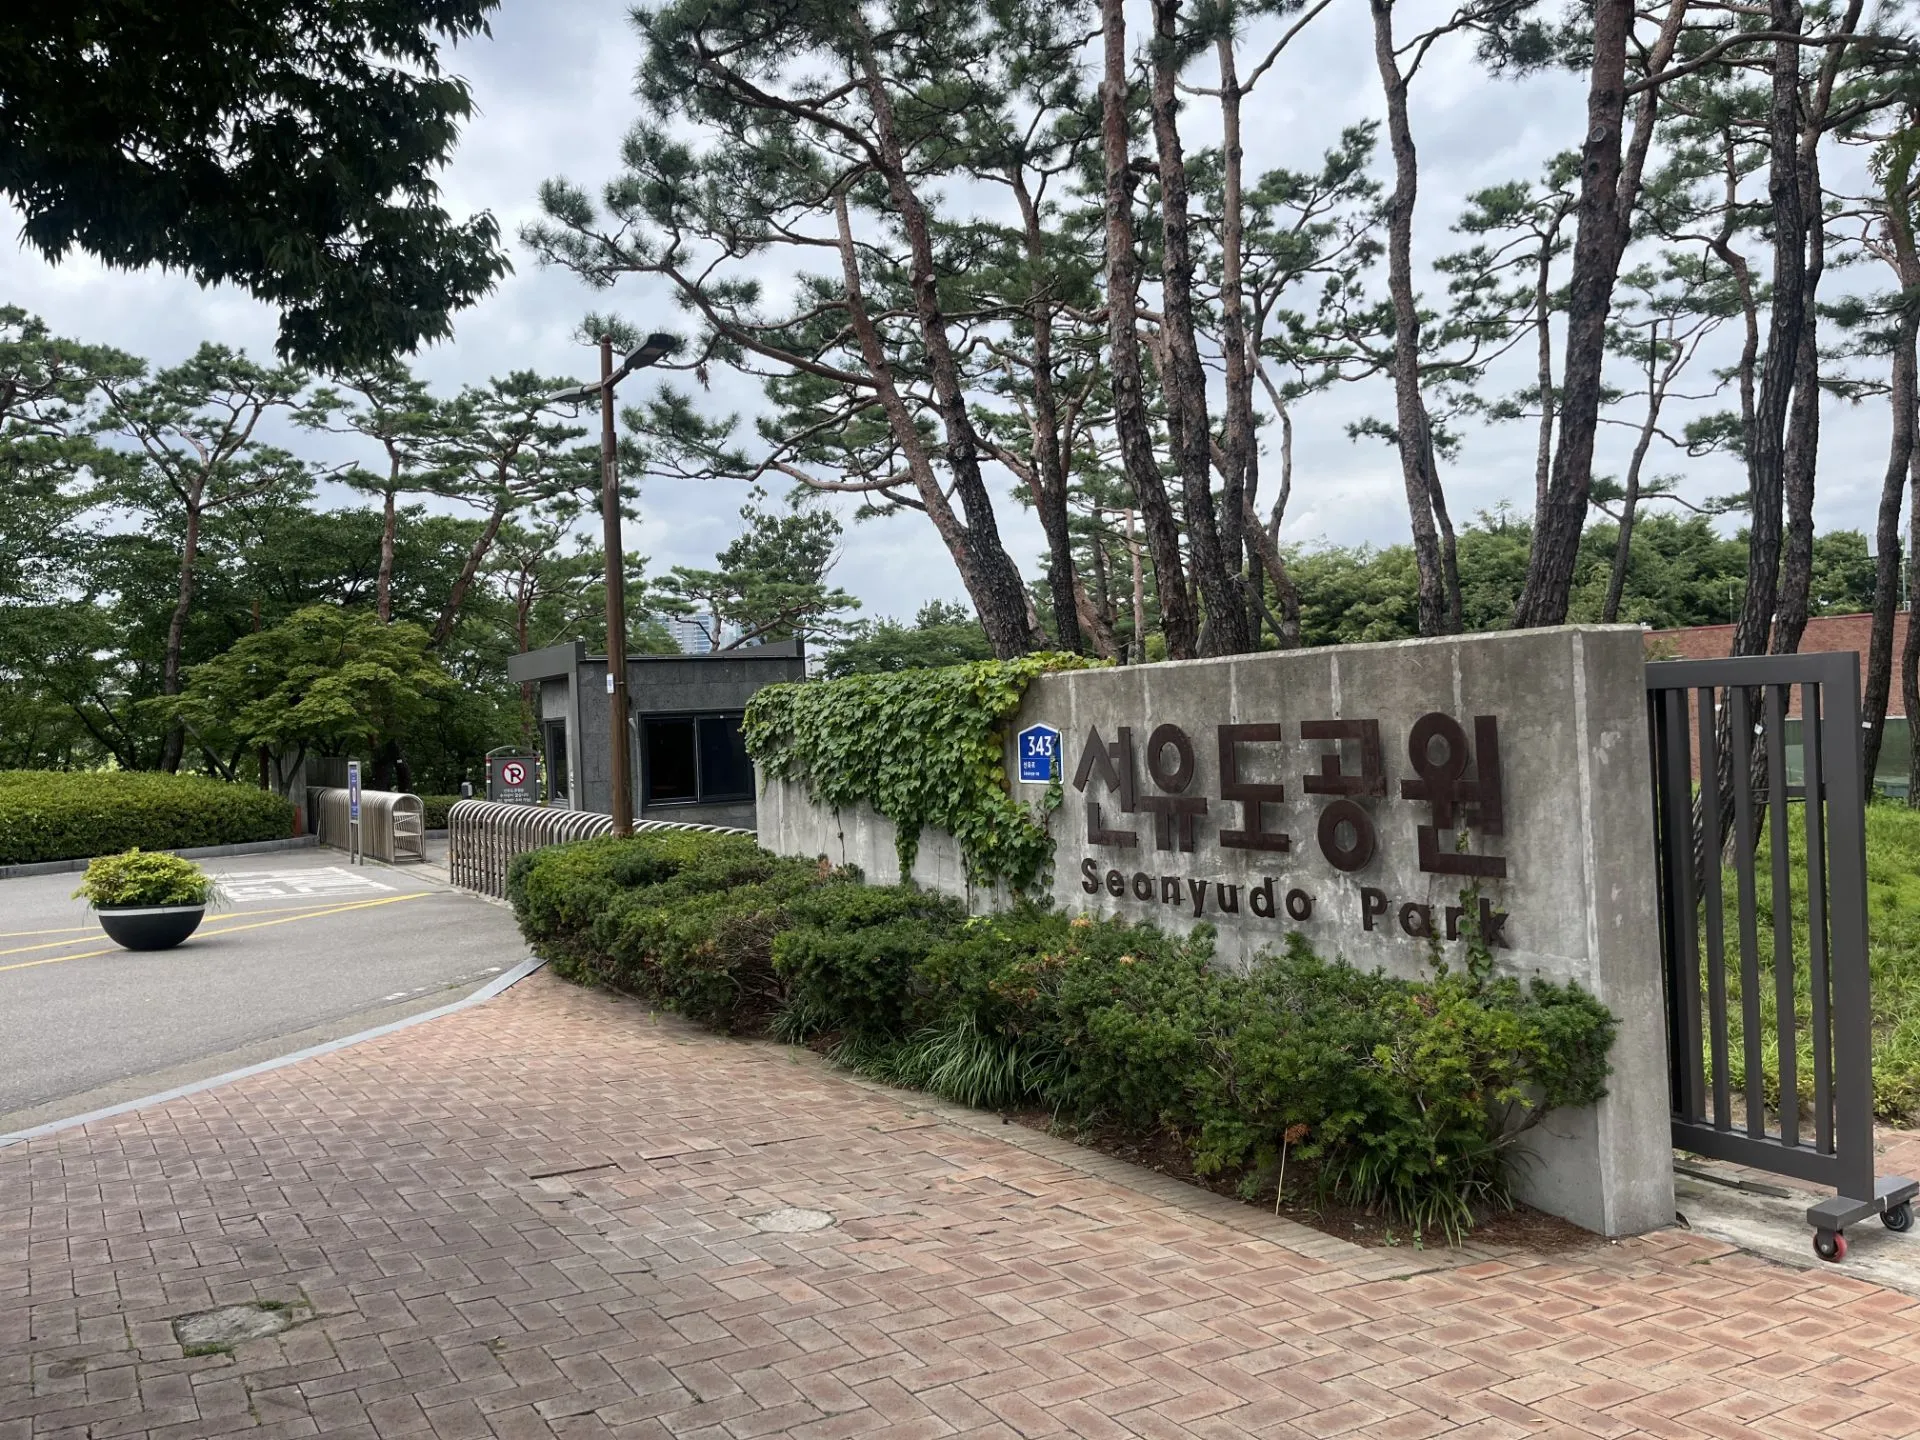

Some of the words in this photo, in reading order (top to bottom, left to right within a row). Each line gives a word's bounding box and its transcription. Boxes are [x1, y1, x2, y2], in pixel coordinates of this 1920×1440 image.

[1027, 735, 1052, 756] 343
[1073, 711, 1507, 878] 선유도공원
[1081, 857, 1312, 922] Seonyudo
[1361, 887, 1510, 949] Park
